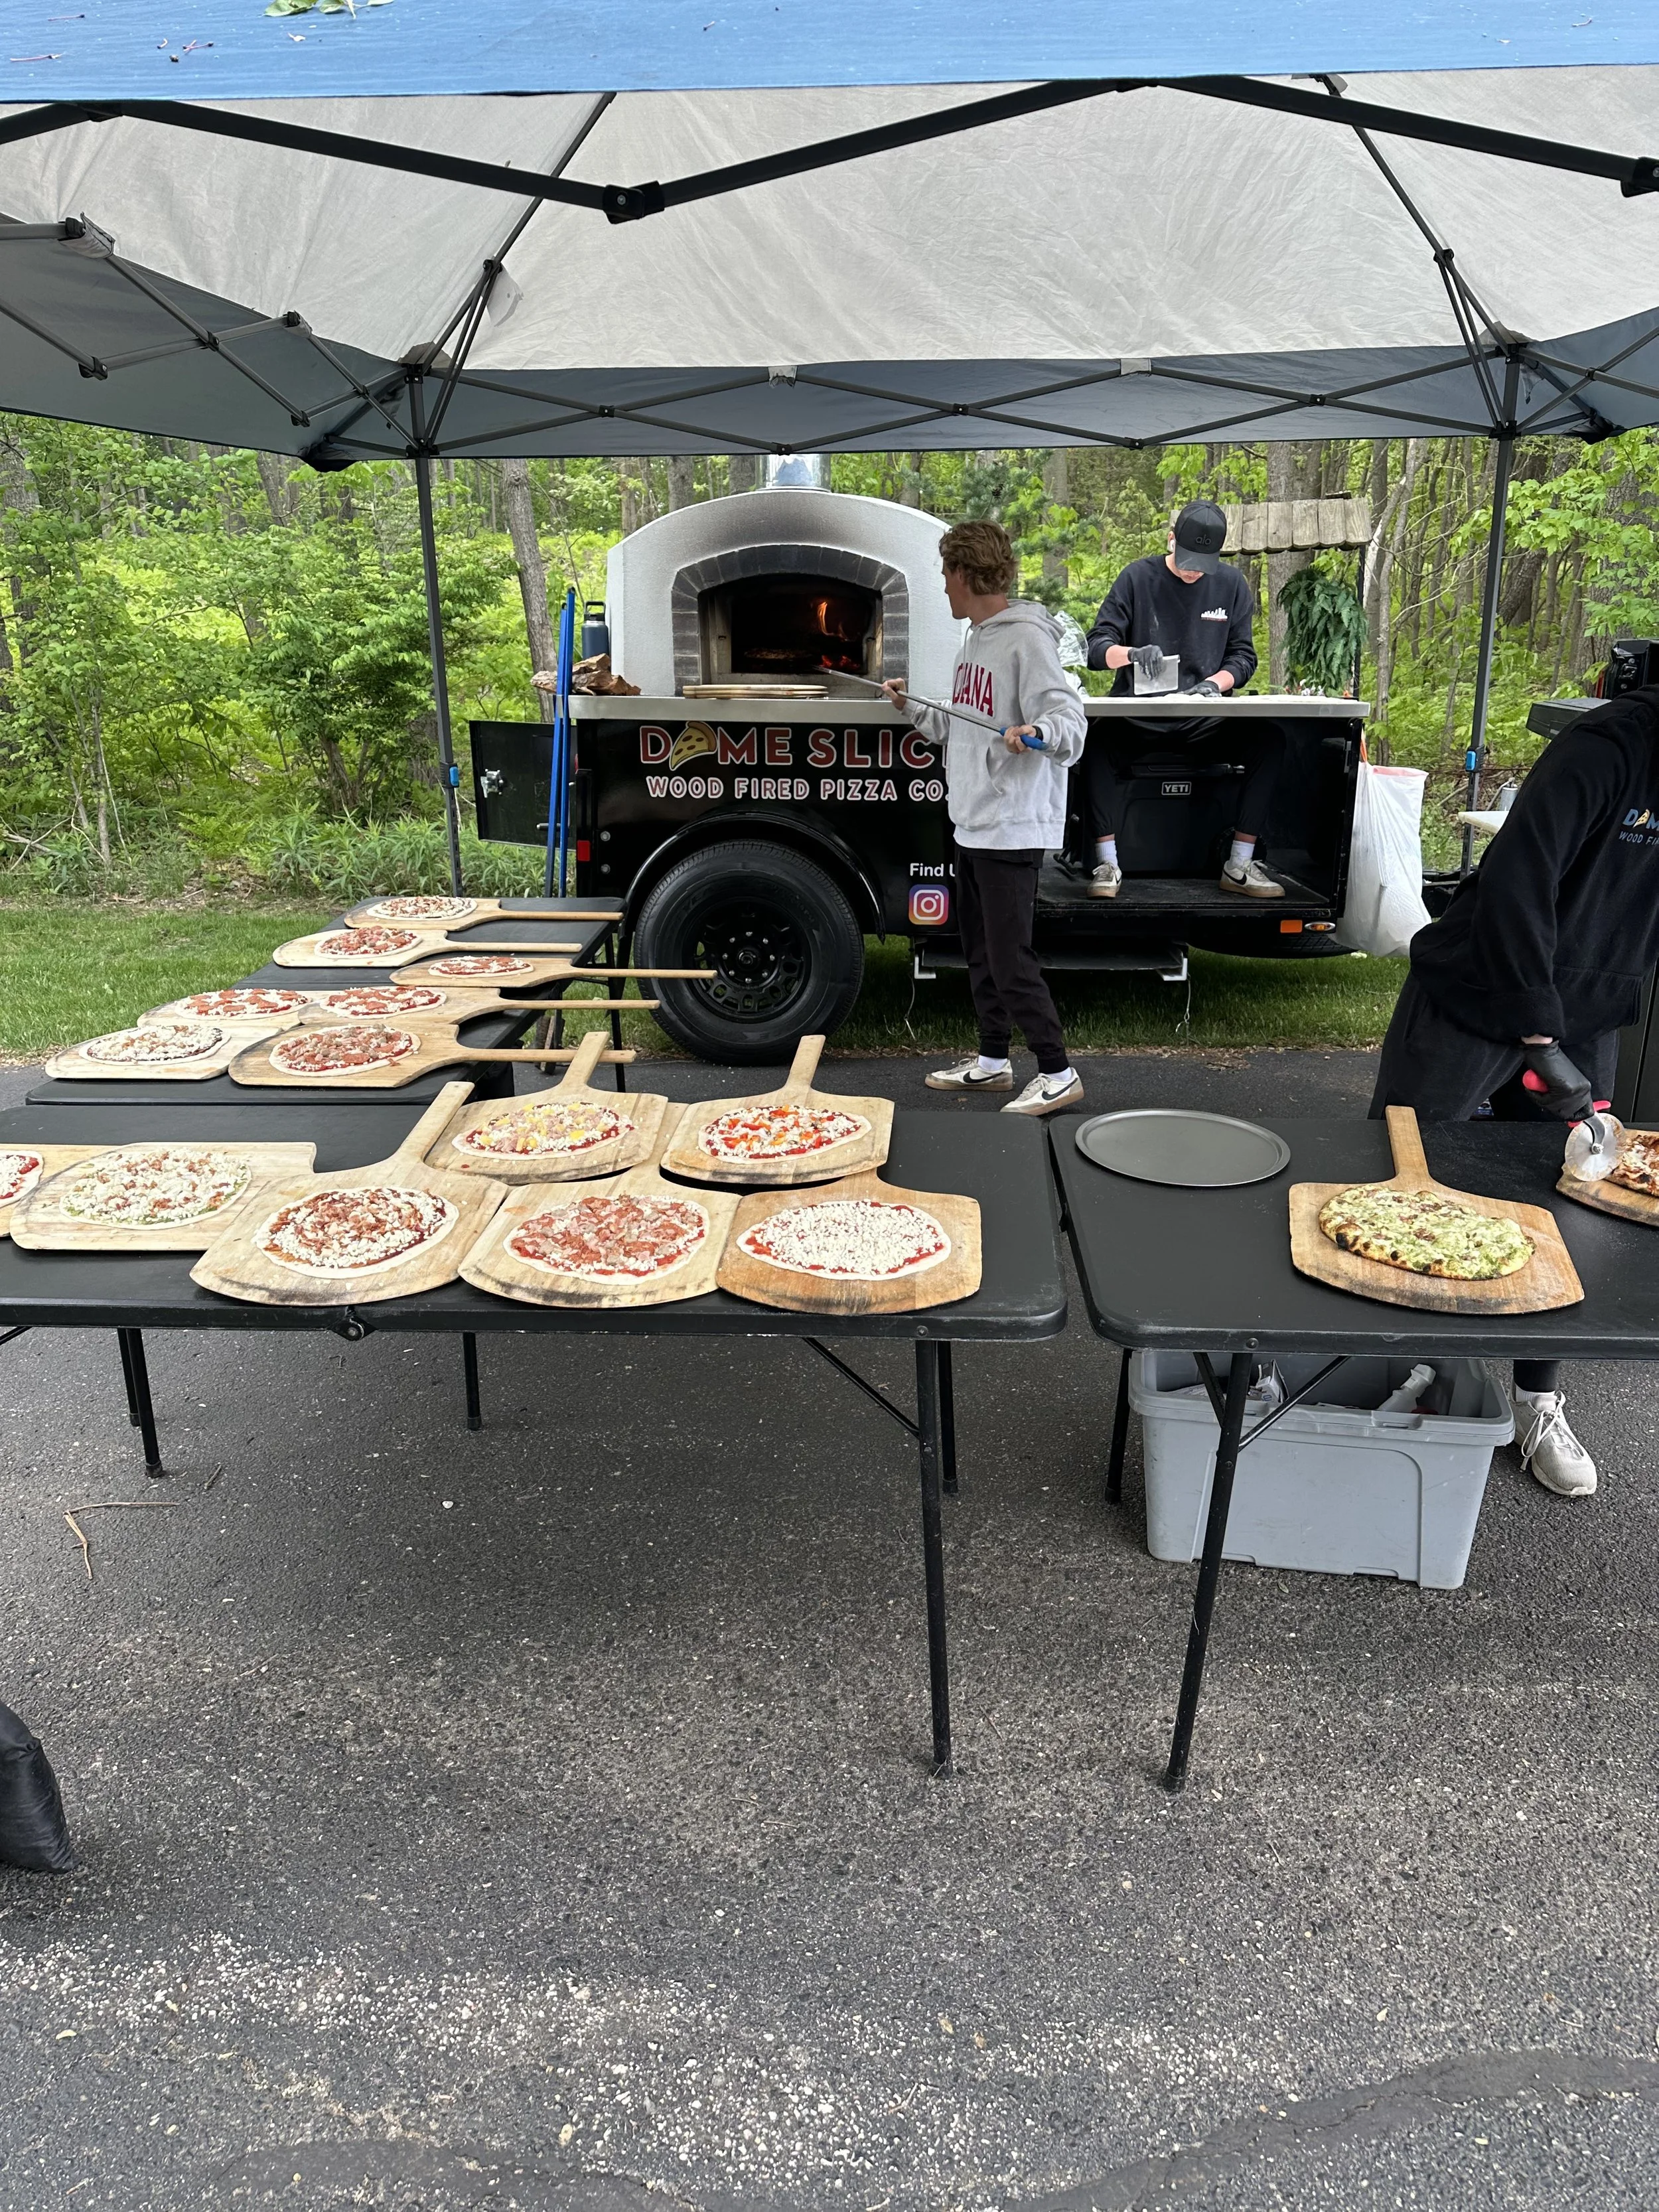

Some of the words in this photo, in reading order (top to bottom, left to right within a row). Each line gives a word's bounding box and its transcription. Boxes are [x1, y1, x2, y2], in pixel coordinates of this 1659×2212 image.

[1196, 534, 1212, 546] alo
[640, 721, 792, 771] DME
[807, 728, 948, 769] SLIC
[646, 775, 724, 798] WOOD
[735, 777, 810, 800] FIRED
[820, 778, 898, 801] PIZZA
[1619, 831, 1644, 844] WOOD
[910, 863, 944, 877] Find
